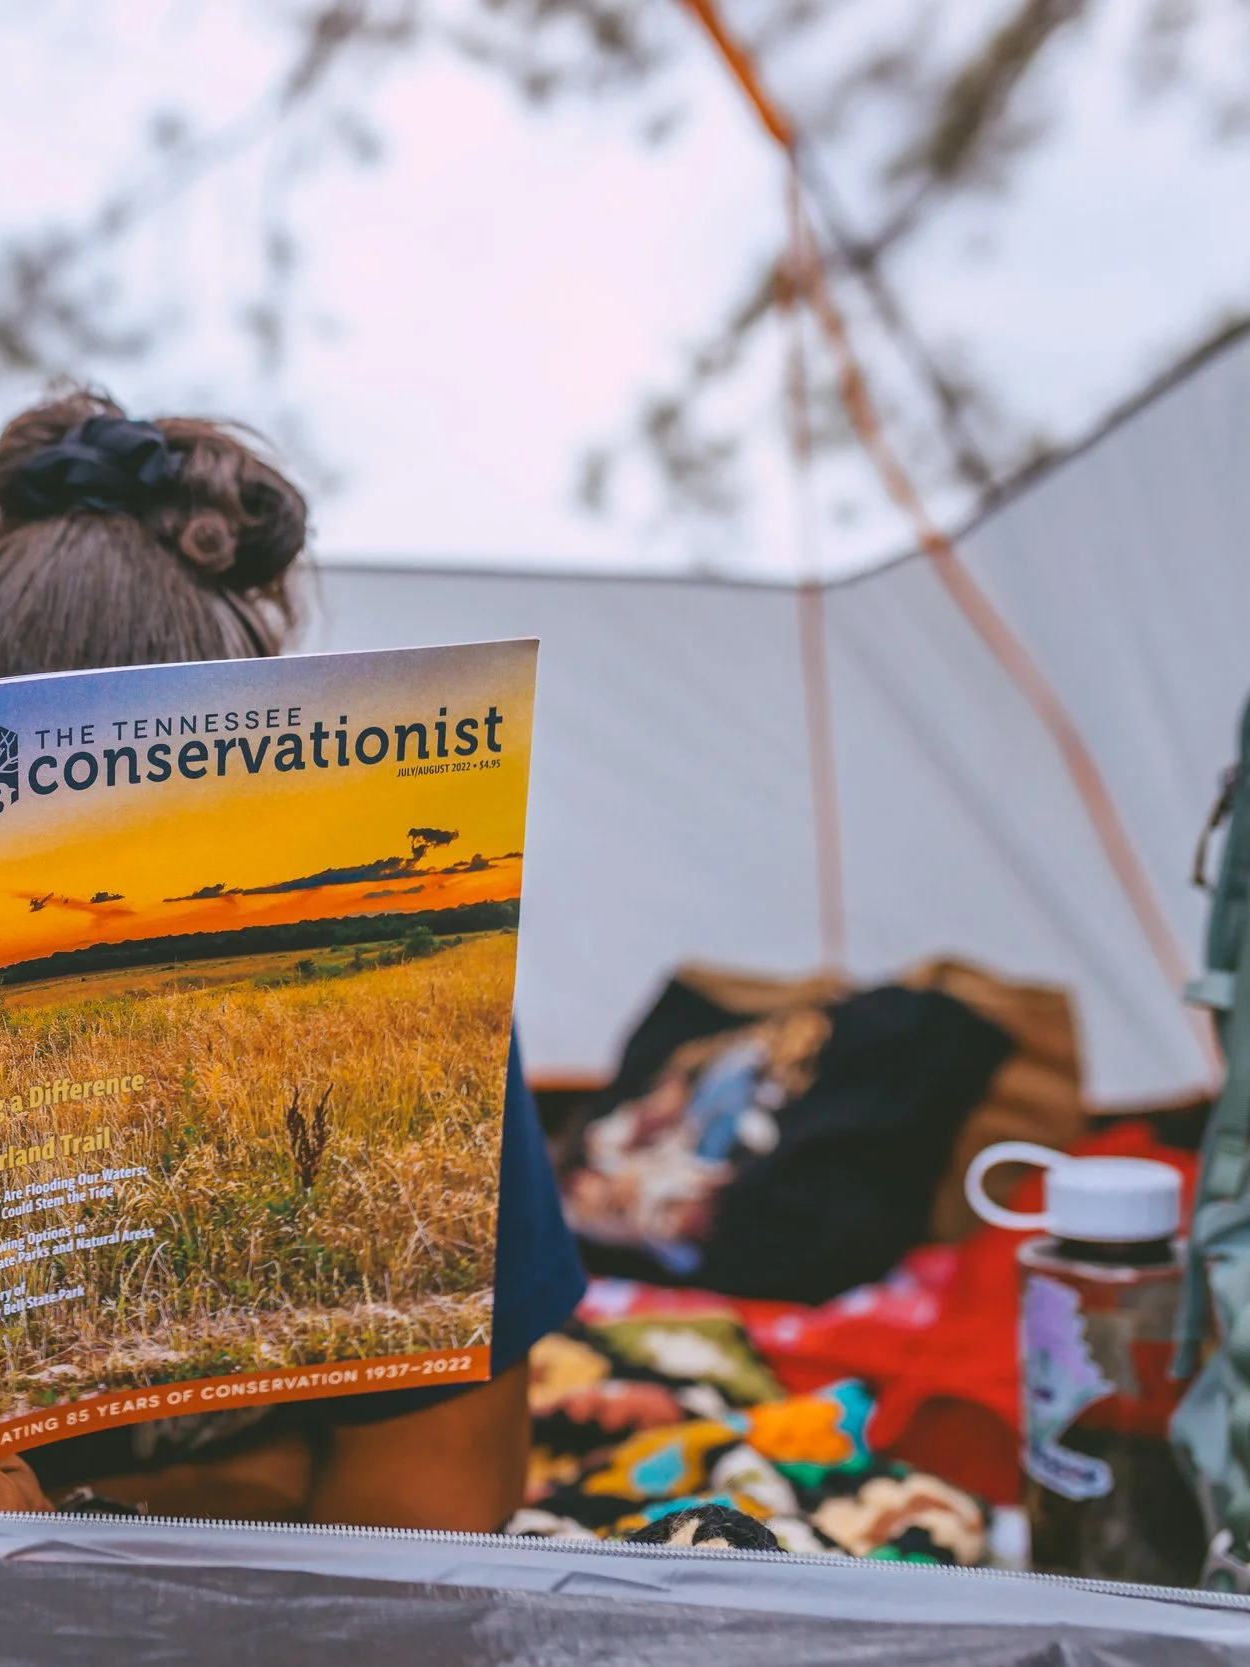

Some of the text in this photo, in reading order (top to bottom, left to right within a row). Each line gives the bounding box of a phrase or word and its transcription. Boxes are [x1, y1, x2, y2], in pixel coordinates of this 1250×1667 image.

[35, 707, 302, 749] THE TENNESSEE
[28, 706, 503, 795] conservationist
[397, 759, 501, 778] JULY/AUGUST 2022 $4.95
[11, 1094, 23, 1113] a
[29, 1073, 145, 1108] Difference
[60, 1126, 111, 1153] Trail
[1, 1202, 33, 1219] Could
[35, 1196, 64, 1211] Stem
[67, 1190, 86, 1205] the
[88, 1186, 114, 1200] Tide
[3, 1189, 22, 1204] Are
[25, 1177, 75, 1200] Flooding
[77, 1172, 100, 1187] Our
[101, 1166, 148, 1182] Waters:
[18, 1247, 49, 1264] Parks
[52, 1240, 74, 1255] and
[76, 1231, 119, 1249] Natural
[121, 1227, 155, 1243] Areas
[27, 1227, 71, 1247] Options
[74, 1223, 86, 1235] in
[3, 1300, 25, 1316] Bell
[27, 1293, 57, 1309] State
[58, 1285, 86, 1302] Park
[14, 1282, 27, 1297] of
[66, 1408, 90, 1426] 85
[96, 1394, 160, 1418] YEARS
[166, 1389, 194, 1405] OF
[200, 1370, 358, 1400] CONSERVATION
